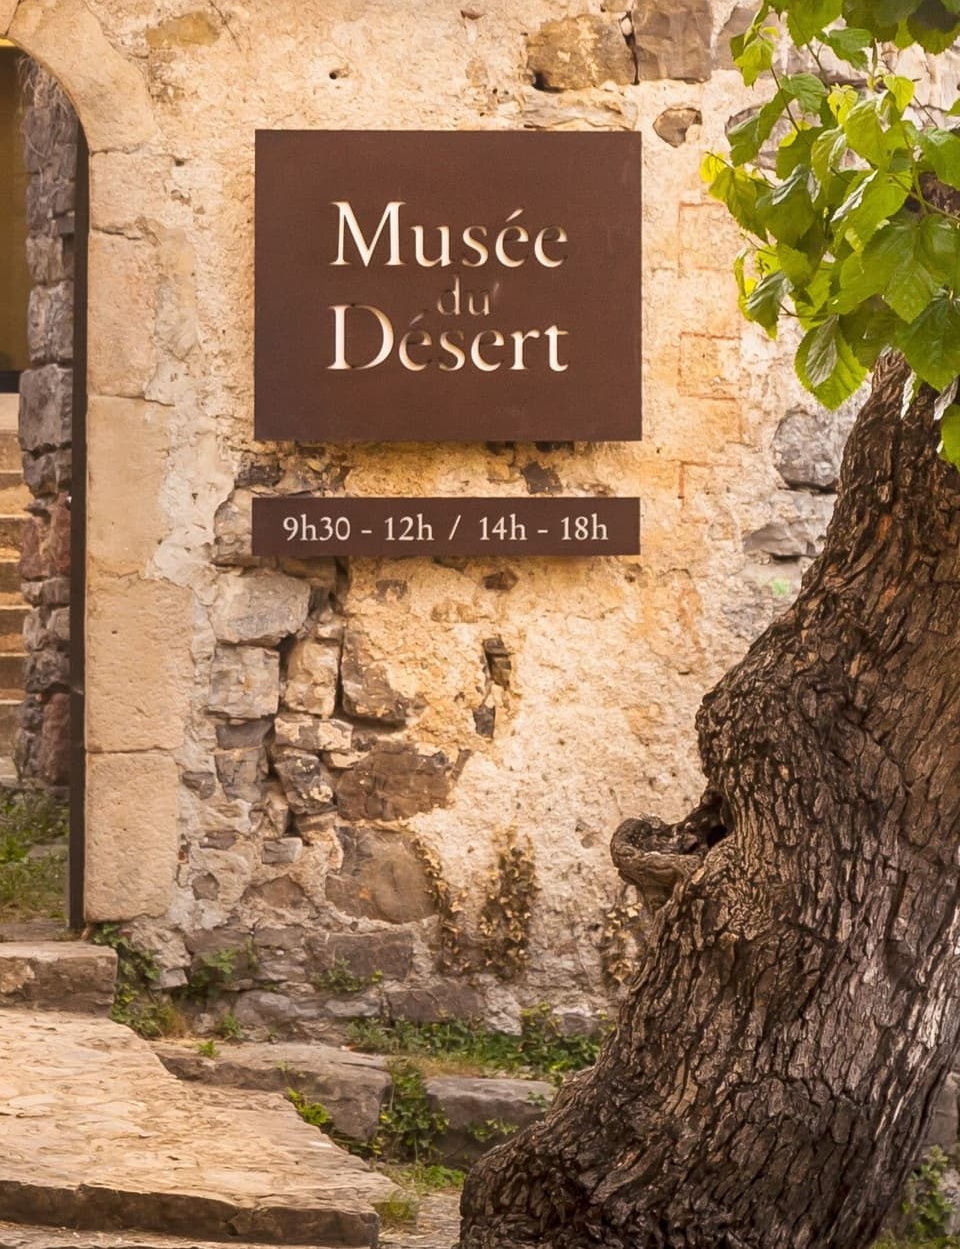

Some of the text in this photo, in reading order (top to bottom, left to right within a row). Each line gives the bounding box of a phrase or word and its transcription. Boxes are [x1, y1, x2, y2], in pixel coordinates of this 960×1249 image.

[328, 201, 569, 268] Musée
[437, 275, 490, 316] du
[326, 303, 570, 372] Désert
[282, 513, 351, 542] 9h30
[384, 513, 435, 542] 12h
[478, 513, 528, 542] 14h
[560, 512, 609, 542] 18h
